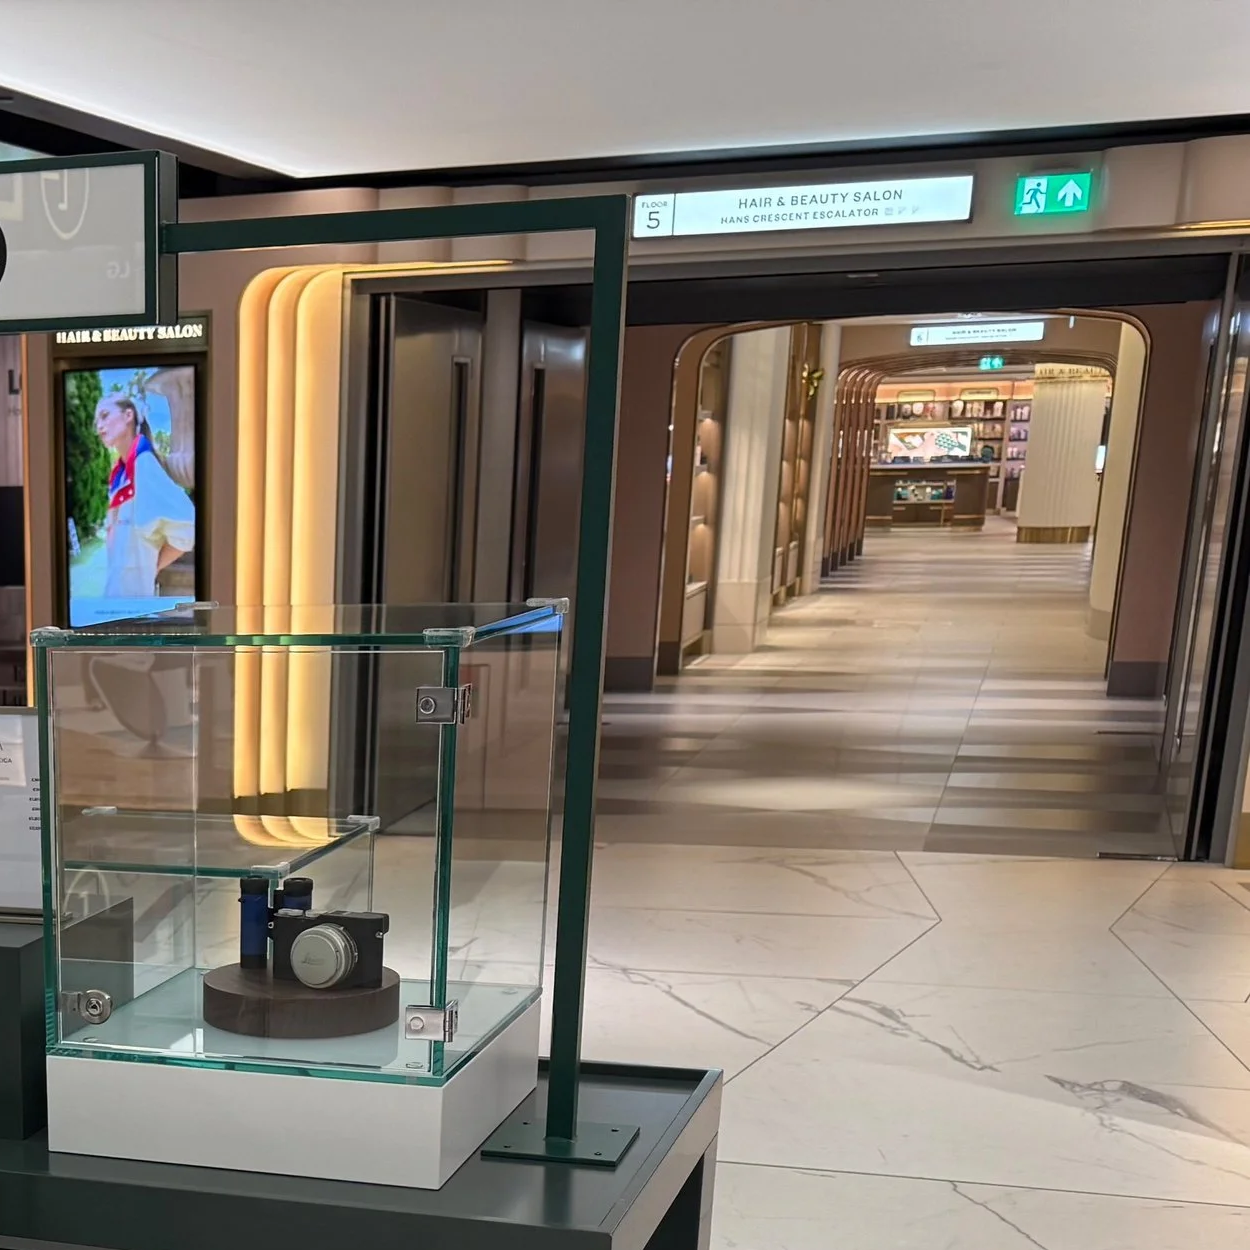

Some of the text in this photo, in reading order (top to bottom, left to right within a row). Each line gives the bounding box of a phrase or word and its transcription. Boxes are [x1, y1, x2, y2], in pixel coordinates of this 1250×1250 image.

[738, 189, 904, 210] HAIR & BEAUTY SALON
[646, 211, 660, 229] 5
[720, 208, 879, 225] HANS CRESCENT ESCALATOR
[56, 324, 203, 344] HAIR & BEAUTY SALON
